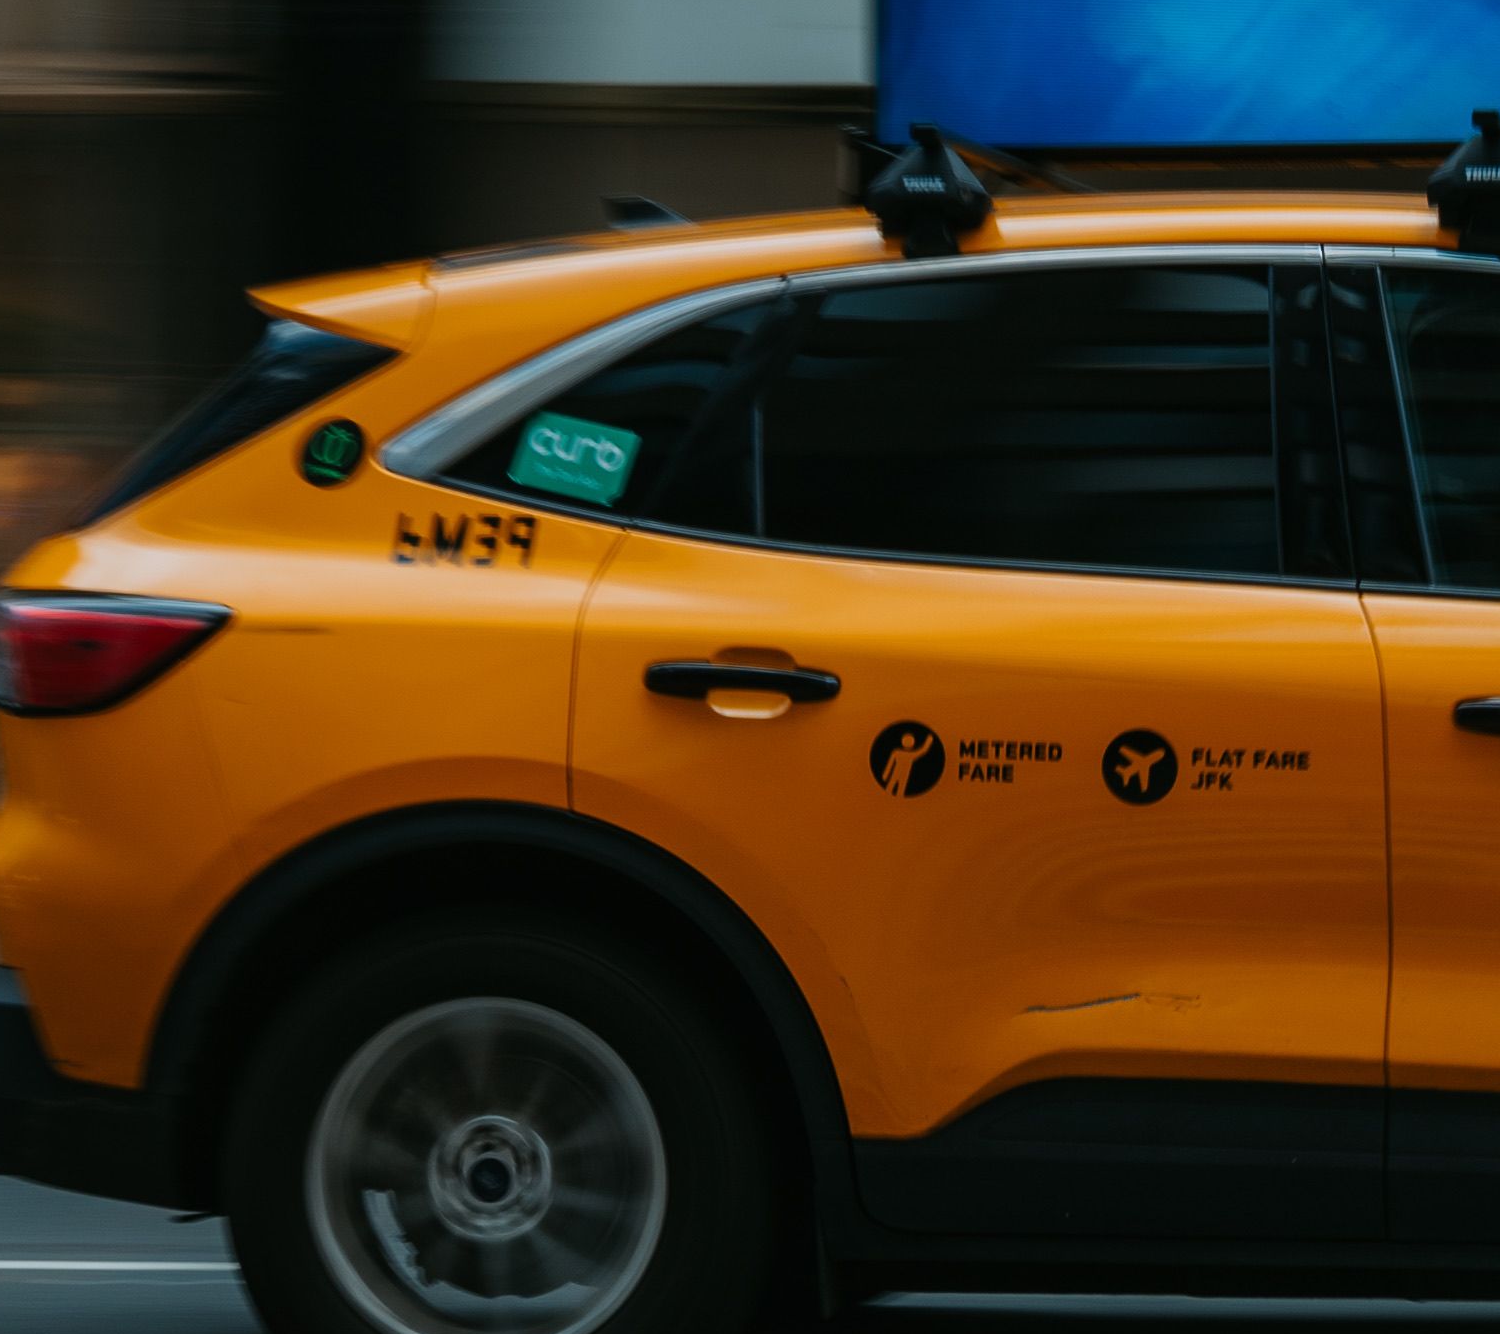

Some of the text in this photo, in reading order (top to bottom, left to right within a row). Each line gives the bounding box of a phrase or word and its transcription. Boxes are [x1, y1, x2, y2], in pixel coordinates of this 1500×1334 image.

[529, 427, 626, 473] curb
[959, 739, 1063, 762] METERED
[1191, 747, 1311, 771] FLAT FARE
[958, 762, 1014, 784] FARE
[1190, 771, 1233, 791] JFK
